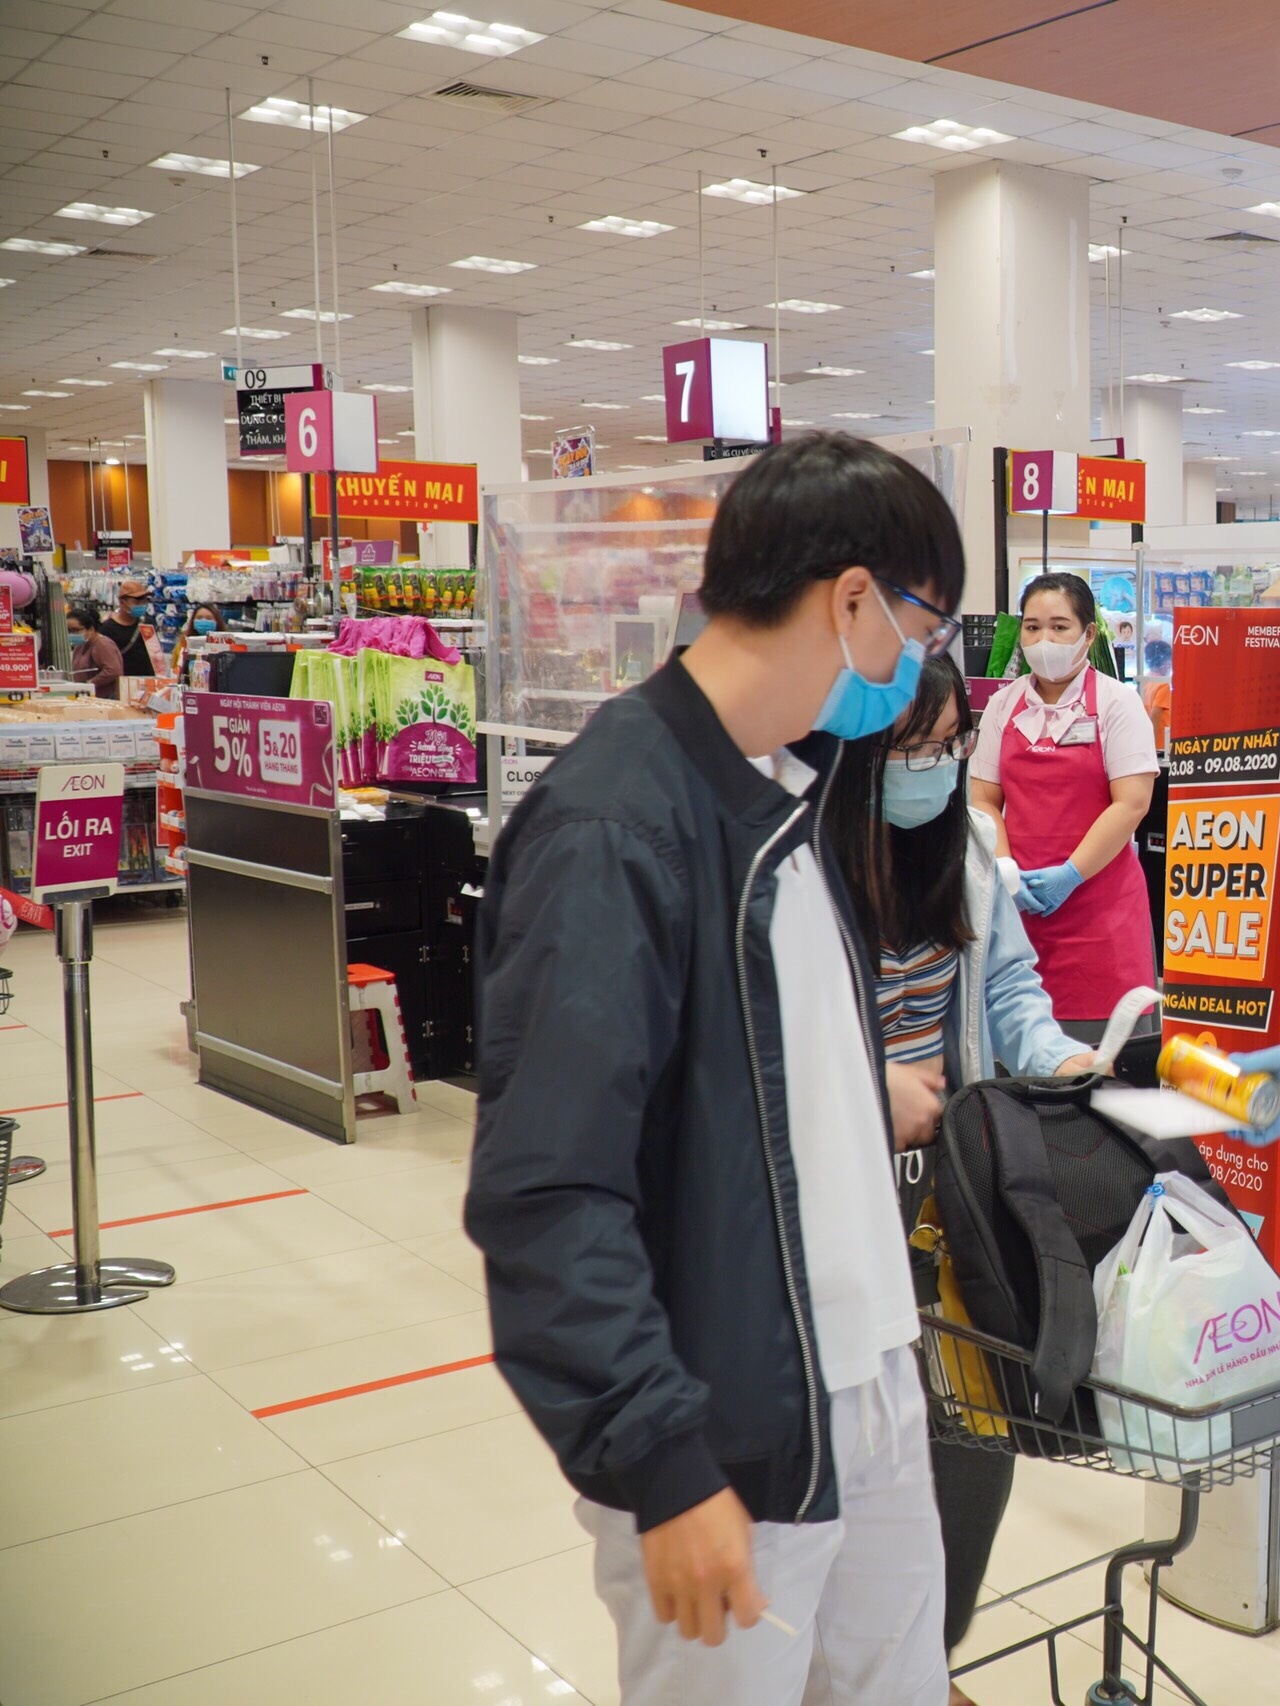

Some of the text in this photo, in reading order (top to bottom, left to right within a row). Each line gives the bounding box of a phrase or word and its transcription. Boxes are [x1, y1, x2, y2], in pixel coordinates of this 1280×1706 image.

[245, 370, 266, 388] 09
[675, 360, 694, 422] 7
[299, 407, 317, 457] 6
[425, 481, 464, 505] MẠI
[1023, 463, 1039, 500] 8
[1103, 478, 1134, 503] MẠI
[353, 500, 438, 510] PROMOTION
[228, 714, 250, 735] GIẢM
[212, 715, 253, 778] 5%
[1175, 730, 1280, 755] NGÀY DUY NHẤT
[1205, 753, 1278, 774] 09.08.2020
[45, 811, 113, 841] LỐI RA
[1171, 810, 1266, 851] AEON
[63, 843, 93, 858] EXIT
[1170, 863, 1267, 900] SUPER
[1166, 909, 1263, 960] SALE
[1200, 997, 1232, 1014] DEAL
[1236, 1001, 1266, 1017] HOT
[1199, 1141, 1268, 1172] áp dụng cho
